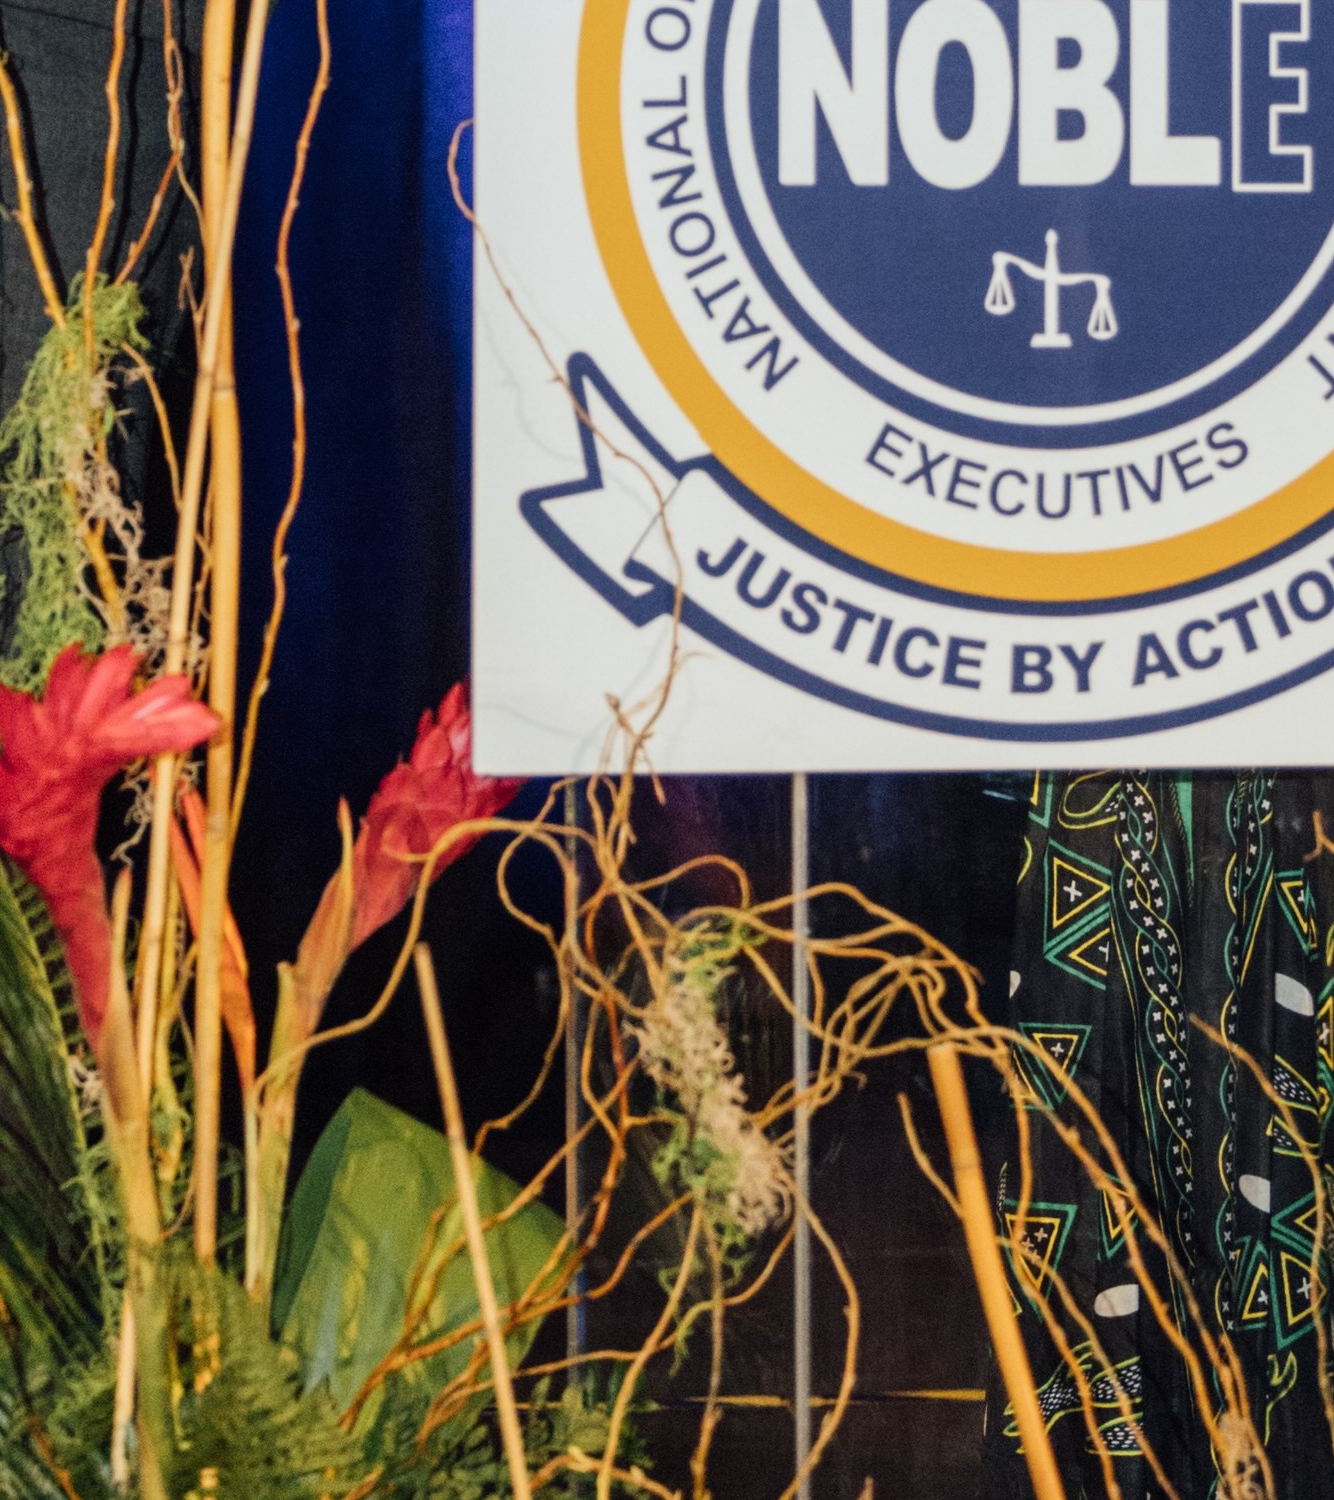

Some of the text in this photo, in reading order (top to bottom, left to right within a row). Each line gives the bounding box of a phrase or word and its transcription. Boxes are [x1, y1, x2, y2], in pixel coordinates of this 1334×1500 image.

[642, 74, 800, 392] NATIONAL
[865, 421, 1249, 520] EXECUTIVES
[695, 537, 987, 691] JUSTICE
[1010, 641, 1104, 695] BY
